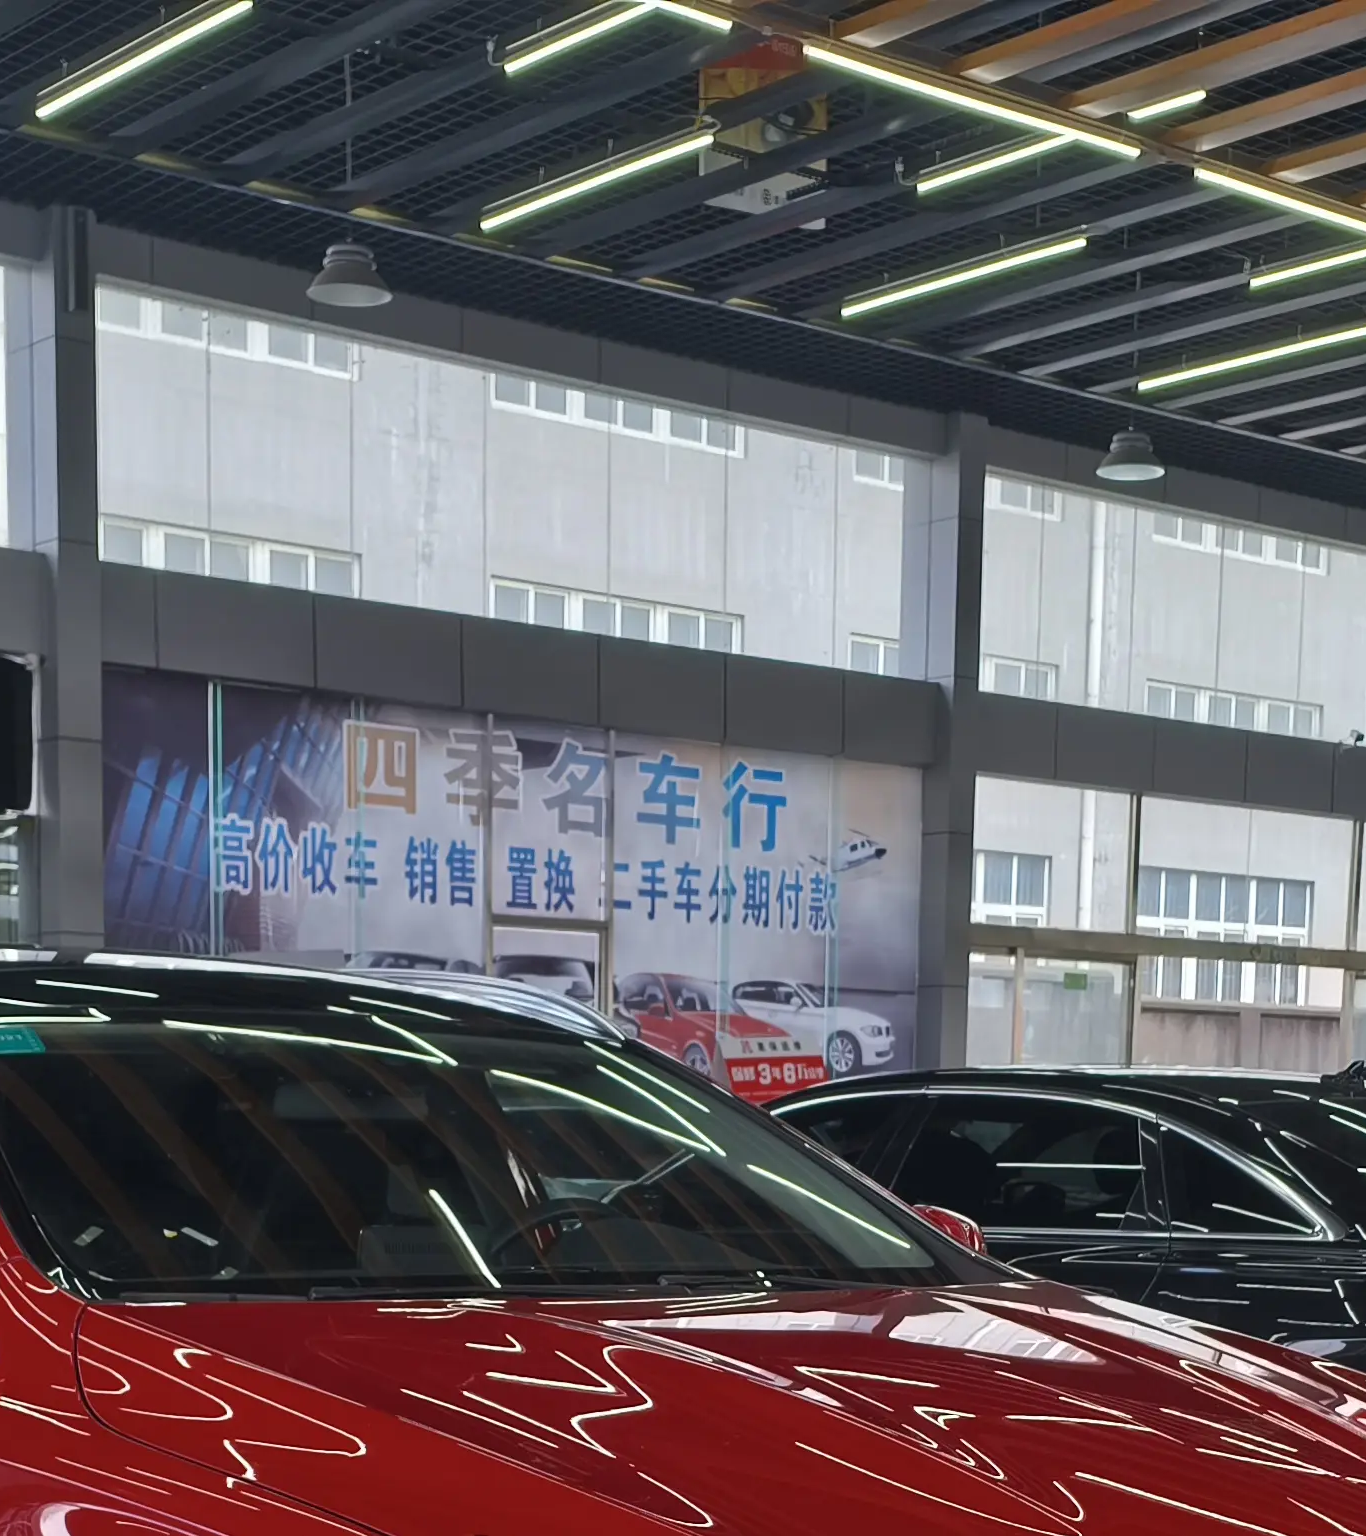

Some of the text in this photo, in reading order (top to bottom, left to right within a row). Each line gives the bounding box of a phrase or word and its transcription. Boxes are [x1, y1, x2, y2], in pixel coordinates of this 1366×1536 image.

[342, 719, 788, 853] 四季名车行
[214, 814, 837, 931] 高价收车 销售 置换 二手车分期付款
